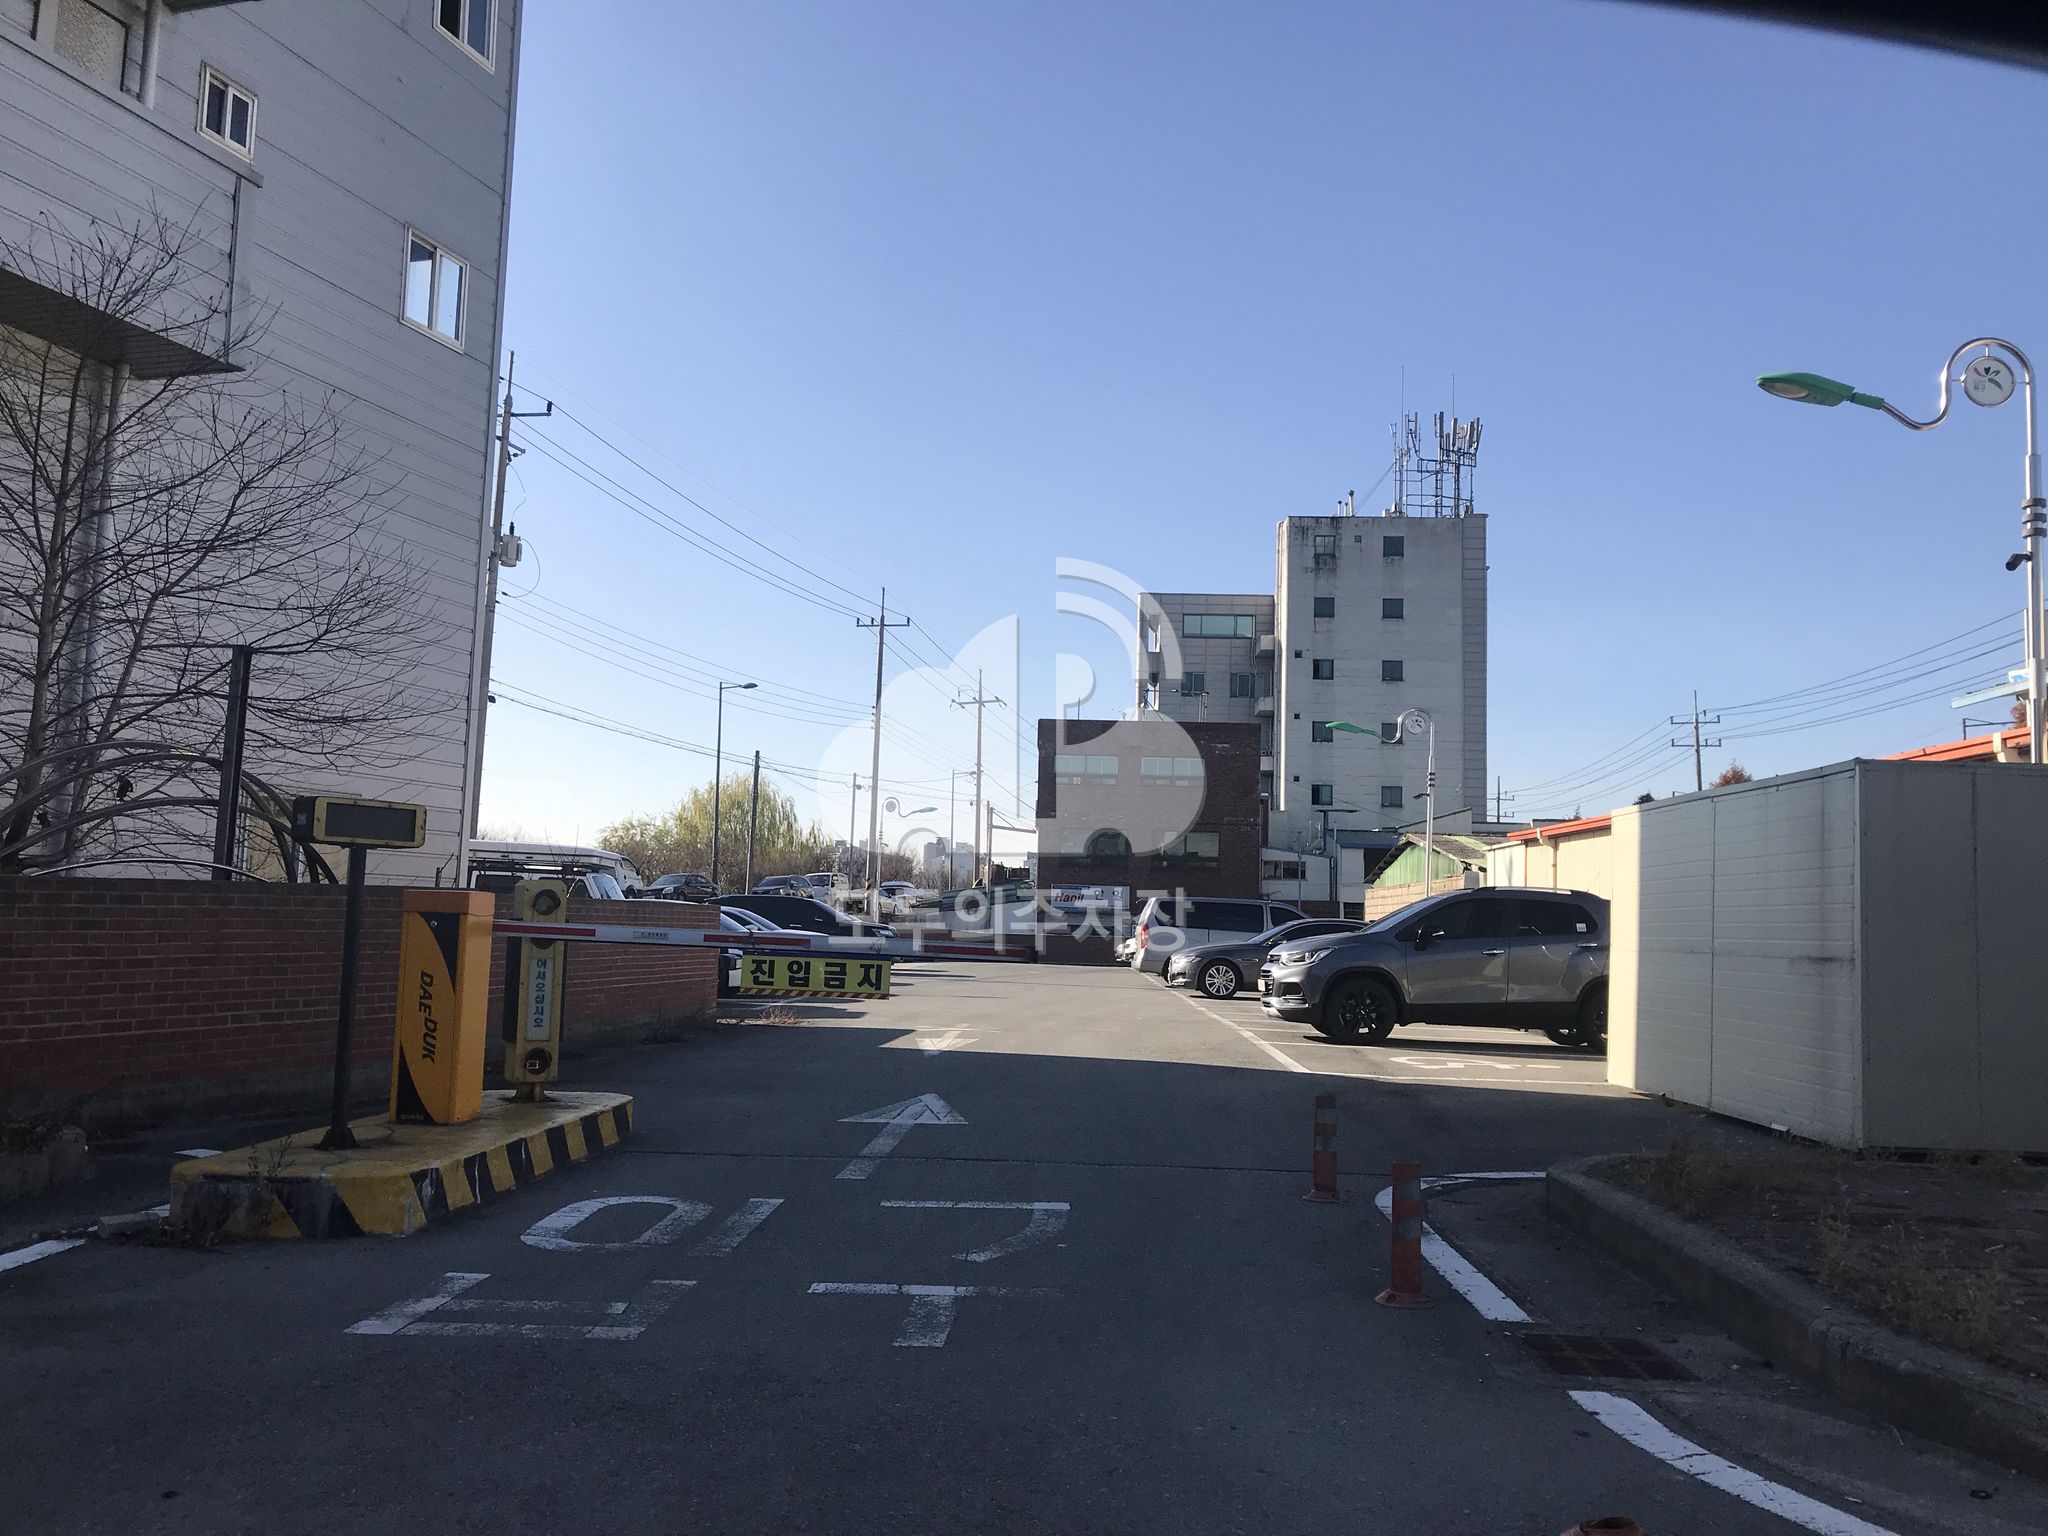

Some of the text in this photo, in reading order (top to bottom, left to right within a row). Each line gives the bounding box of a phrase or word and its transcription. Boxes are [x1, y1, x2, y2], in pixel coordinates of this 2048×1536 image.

[1054, 891, 1085, 903] Hanil
[533, 958, 548, 1028] 어서오십시오
[750, 959, 883, 991] 진입금지
[418, 968, 438, 1065] DAEDUK
[343, 1196, 1072, 1349] 입구
